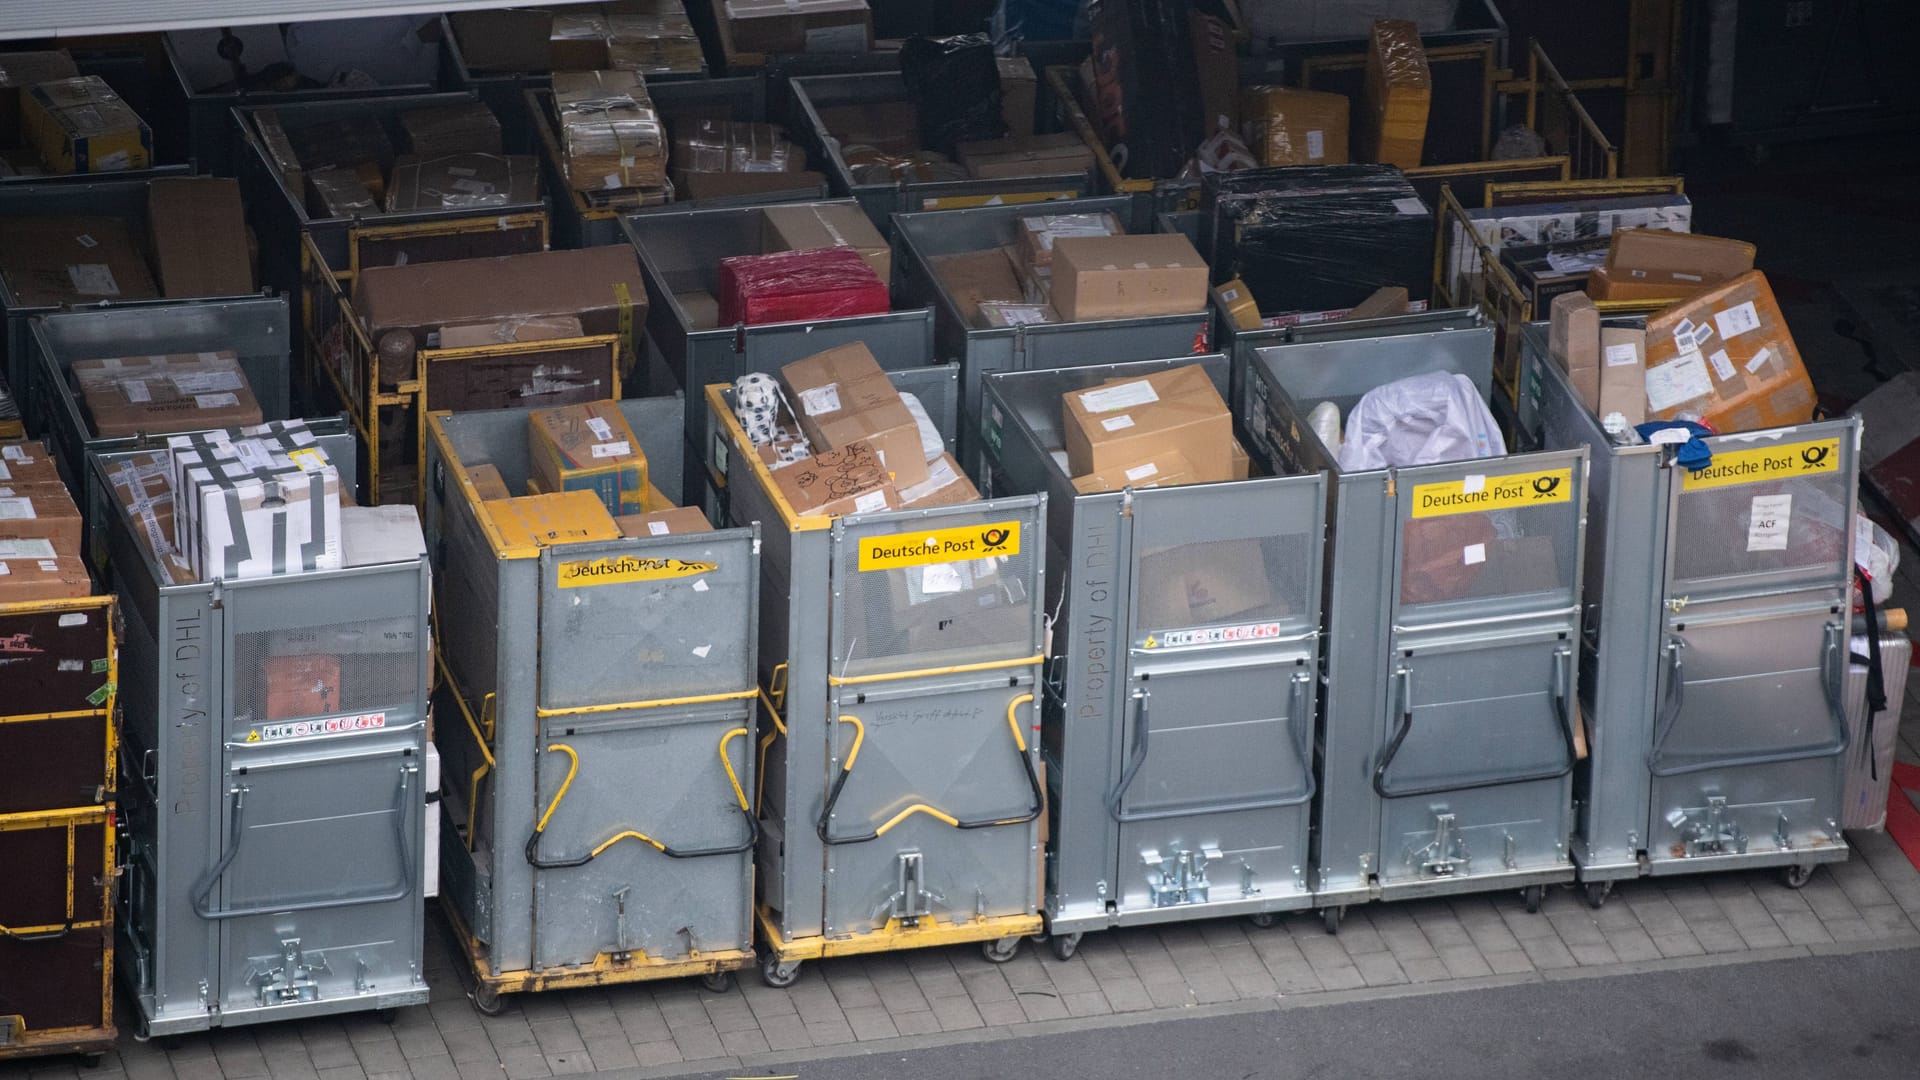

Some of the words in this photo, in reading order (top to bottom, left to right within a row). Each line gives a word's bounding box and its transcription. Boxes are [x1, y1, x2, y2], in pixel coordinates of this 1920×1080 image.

[1693, 462, 1759, 481] Deutsche
[1763, 456, 1793, 471] Post
[1423, 490, 1489, 508] Deutsche
[1494, 485, 1524, 500] Post
[1758, 520, 1777, 529] ACF
[872, 542, 940, 559] Deutsche
[944, 539, 975, 553] Post
[1085, 580, 1108, 602] of
[176, 608, 201, 661] DHL
[1079, 615, 1112, 719] Property
[176, 672, 201, 696] of
